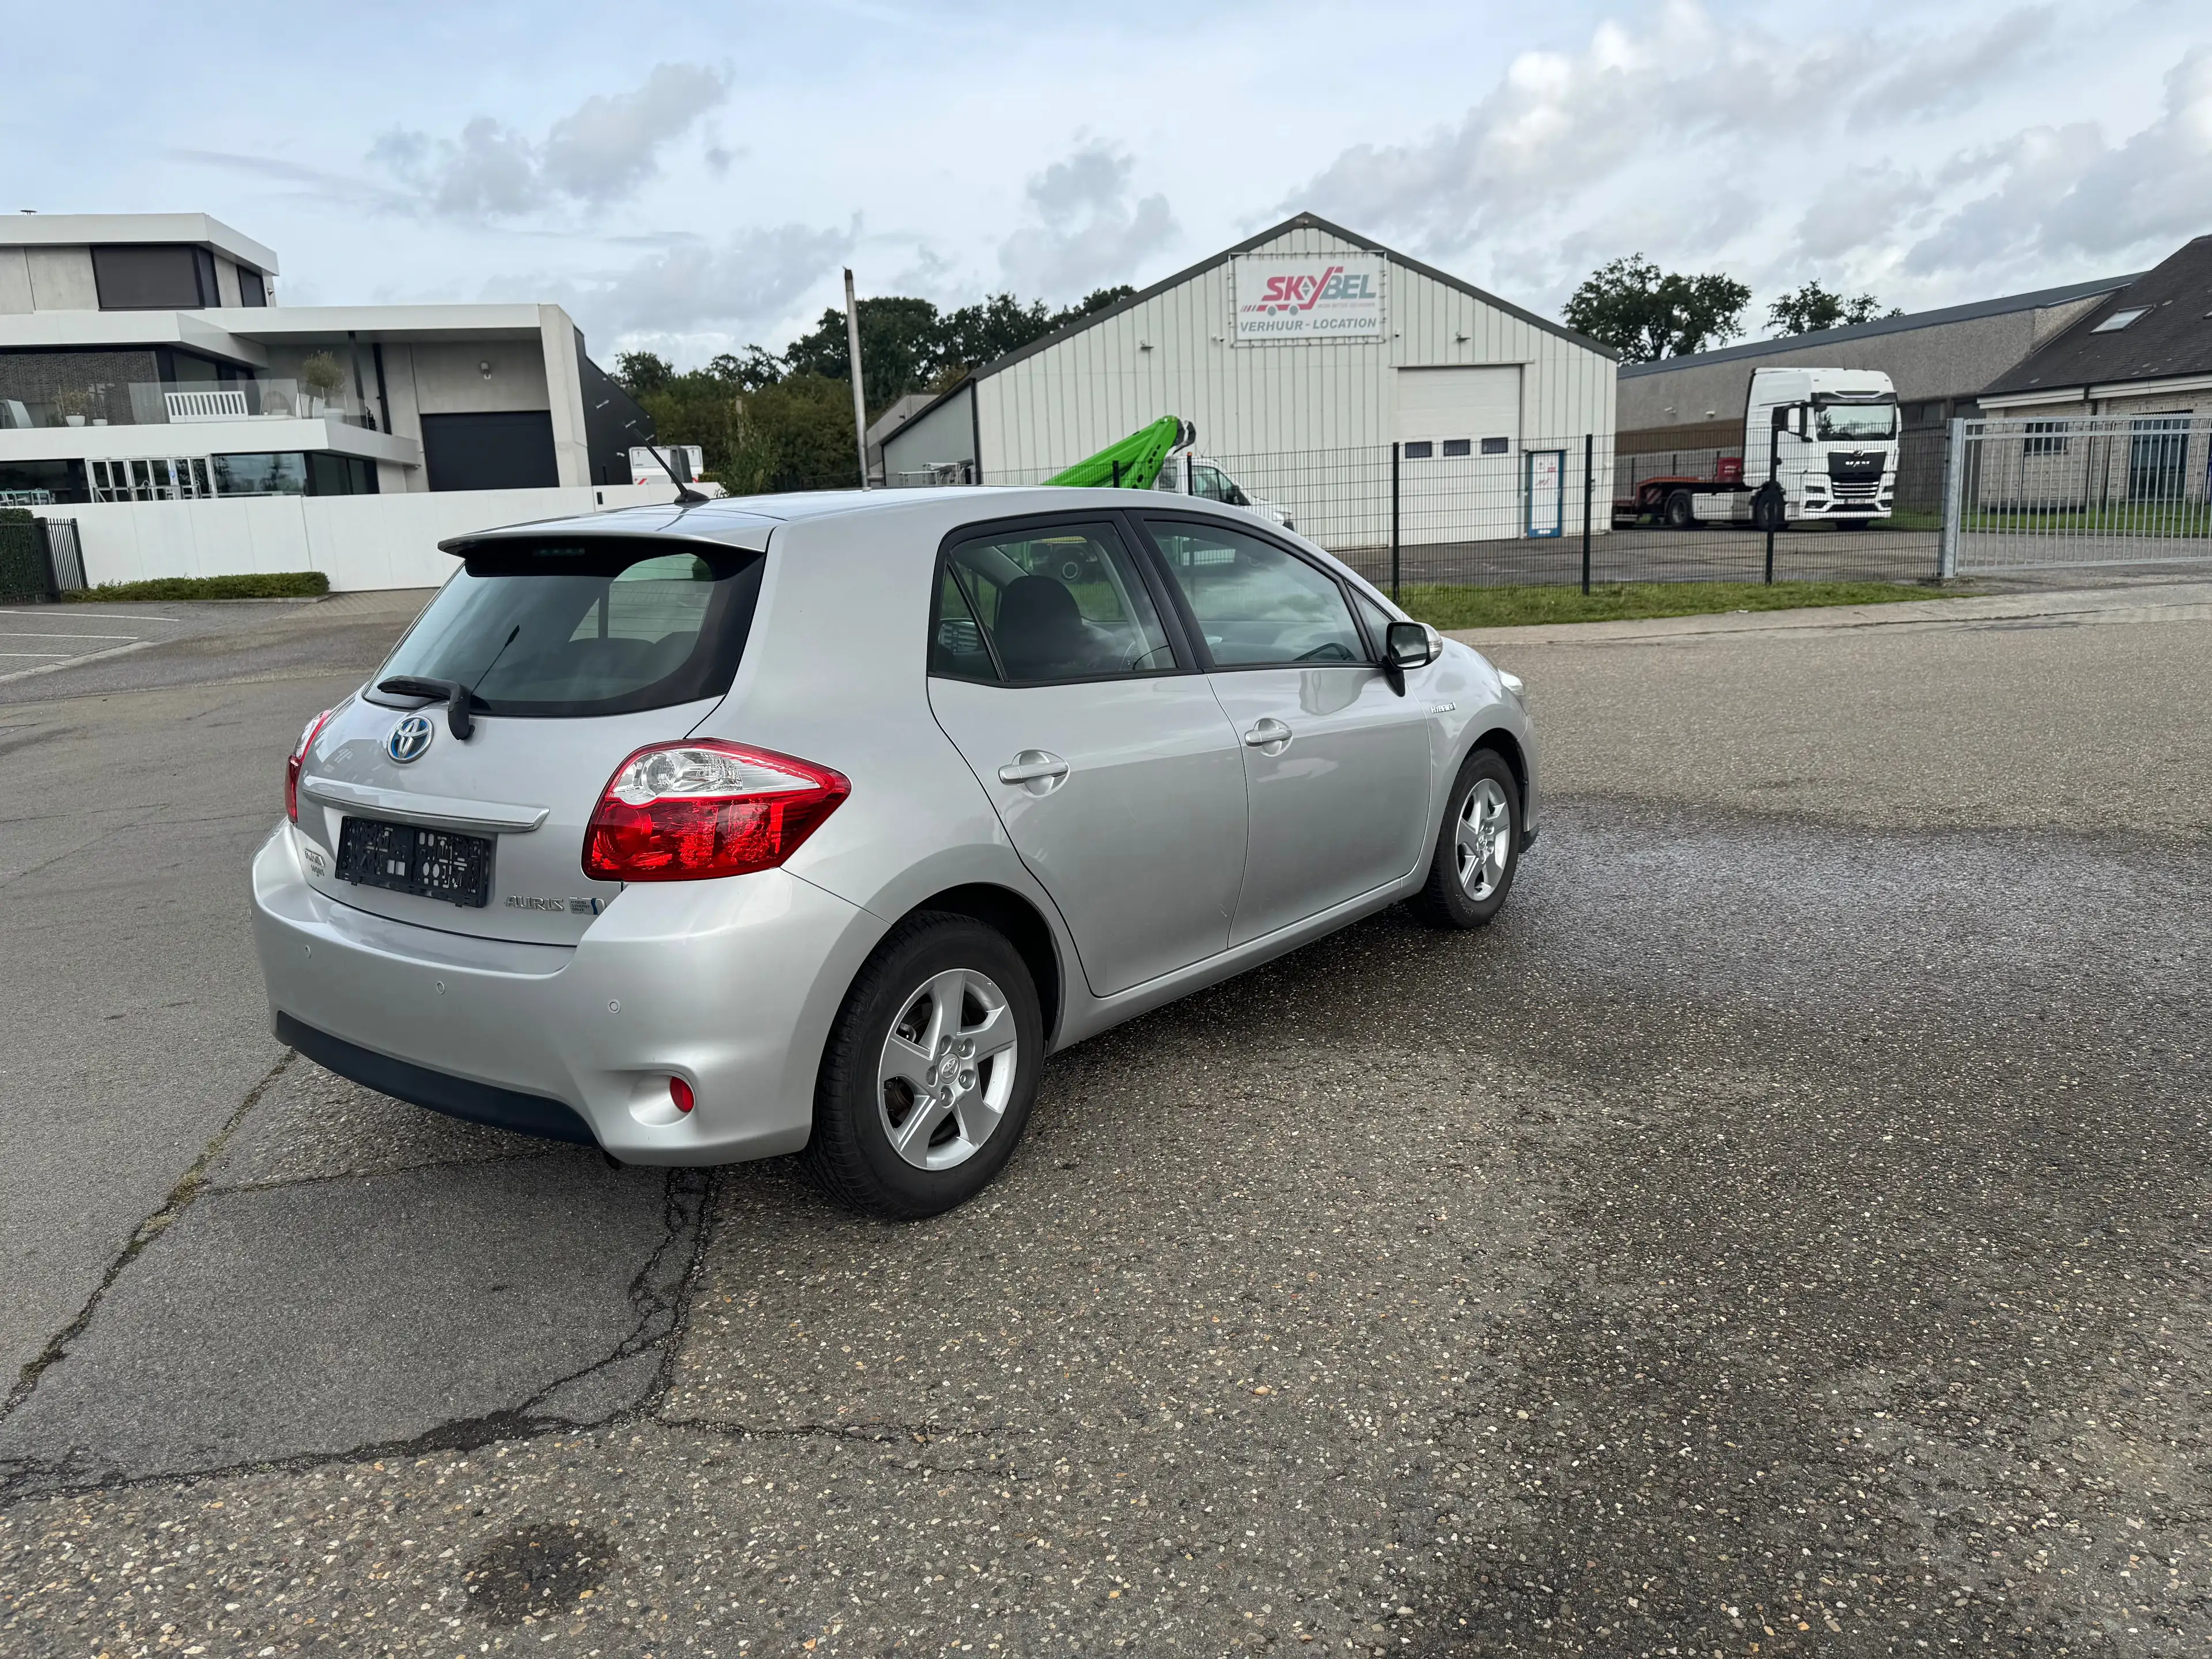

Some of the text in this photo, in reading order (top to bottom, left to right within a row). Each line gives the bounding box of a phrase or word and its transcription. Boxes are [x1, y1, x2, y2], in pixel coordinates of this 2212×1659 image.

[1260, 266, 1377, 310] SKYBEL
[1240, 320, 1303, 332] VERHUUR
[1313, 318, 1377, 329] LOCATION
[504, 895, 565, 911] AURIS
